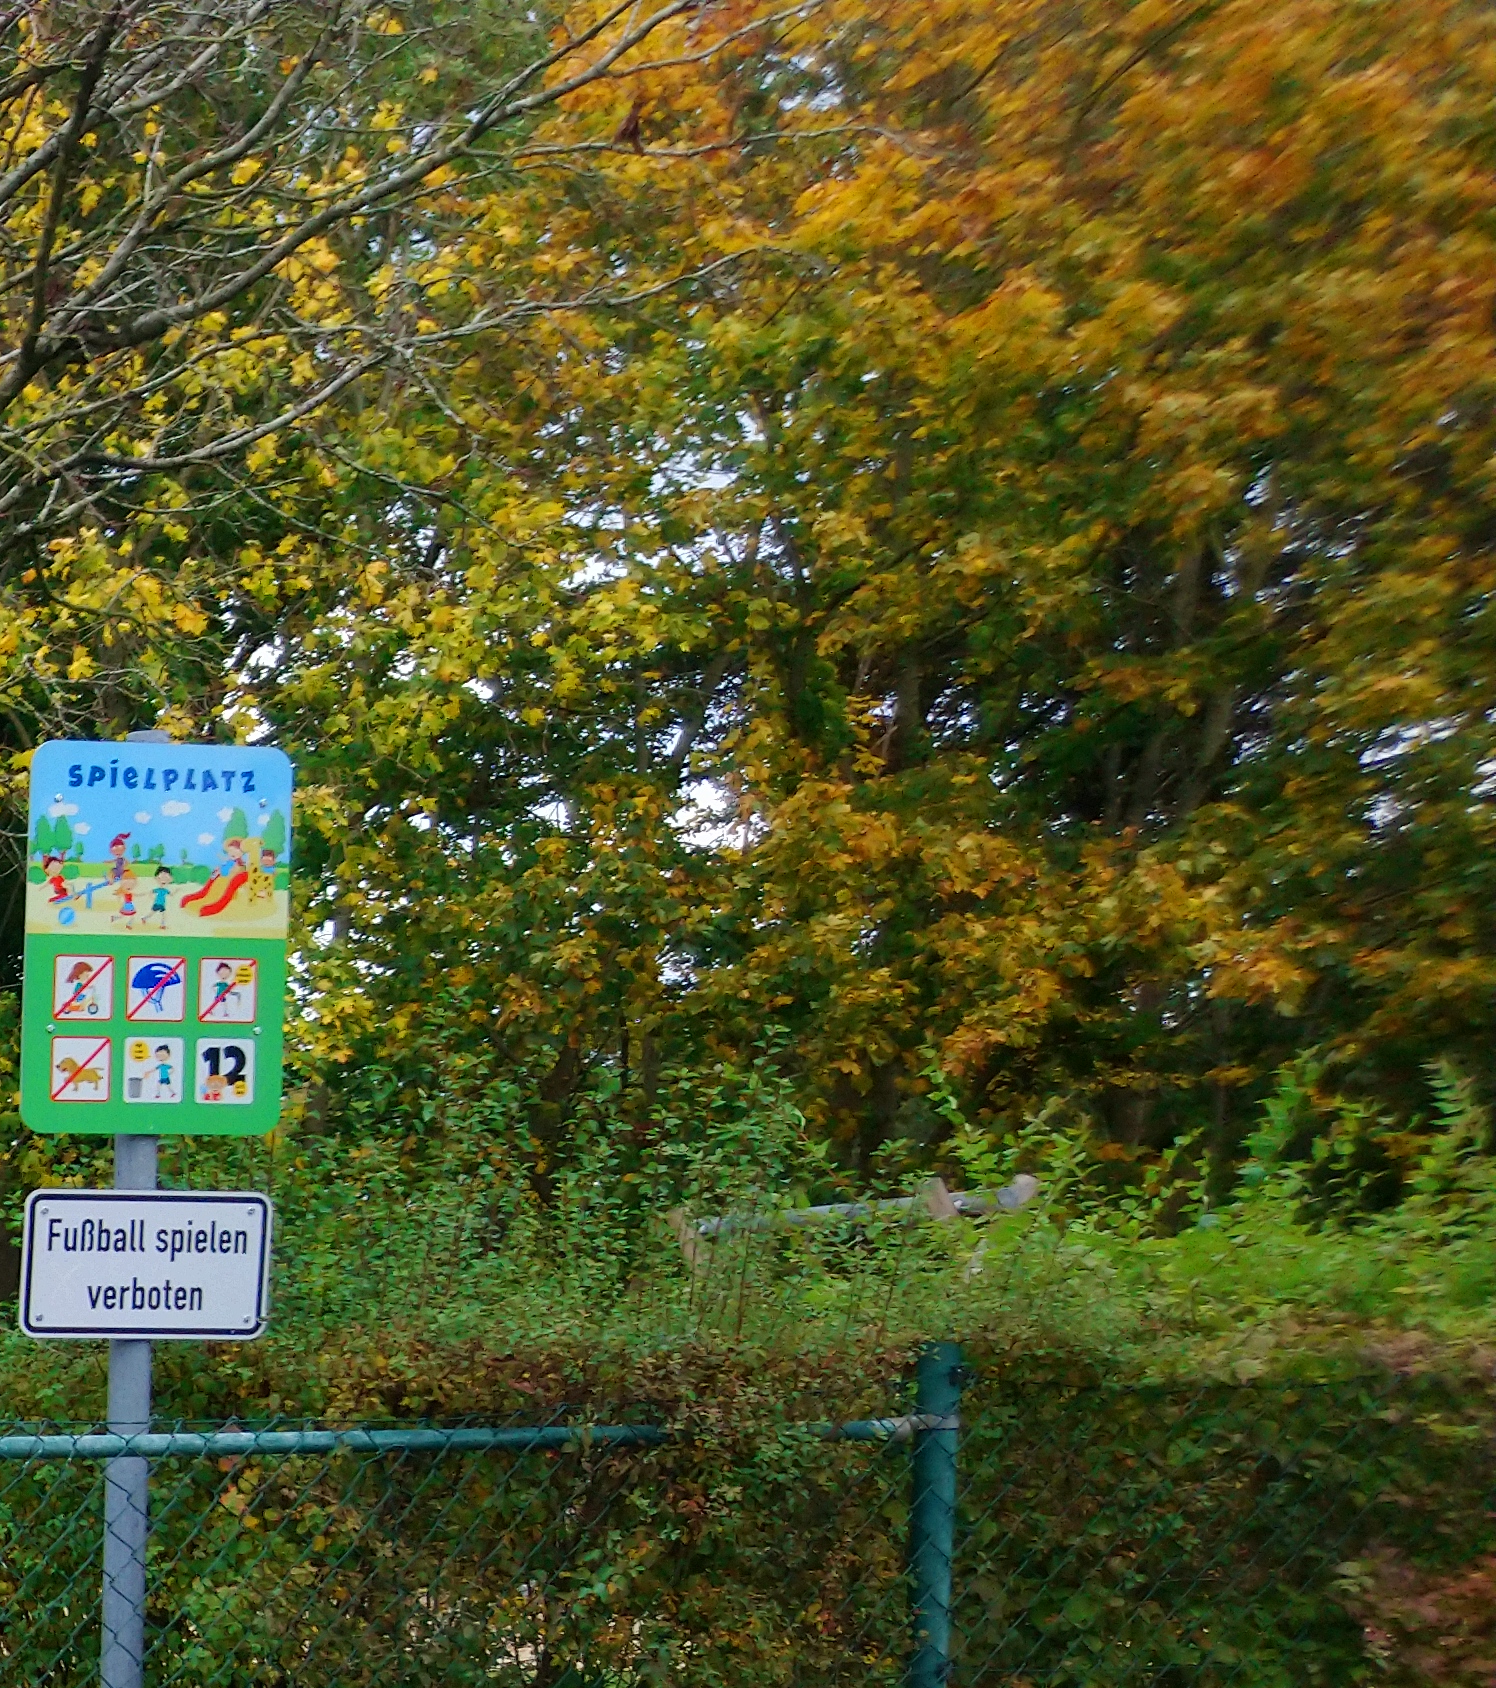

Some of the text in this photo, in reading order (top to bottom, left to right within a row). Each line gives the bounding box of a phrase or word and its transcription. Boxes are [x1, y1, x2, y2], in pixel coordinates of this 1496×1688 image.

[202, 1045, 246, 1086] 12
[47, 1218, 247, 1262] Fußball spielen
[87, 1277, 203, 1311] verboten
